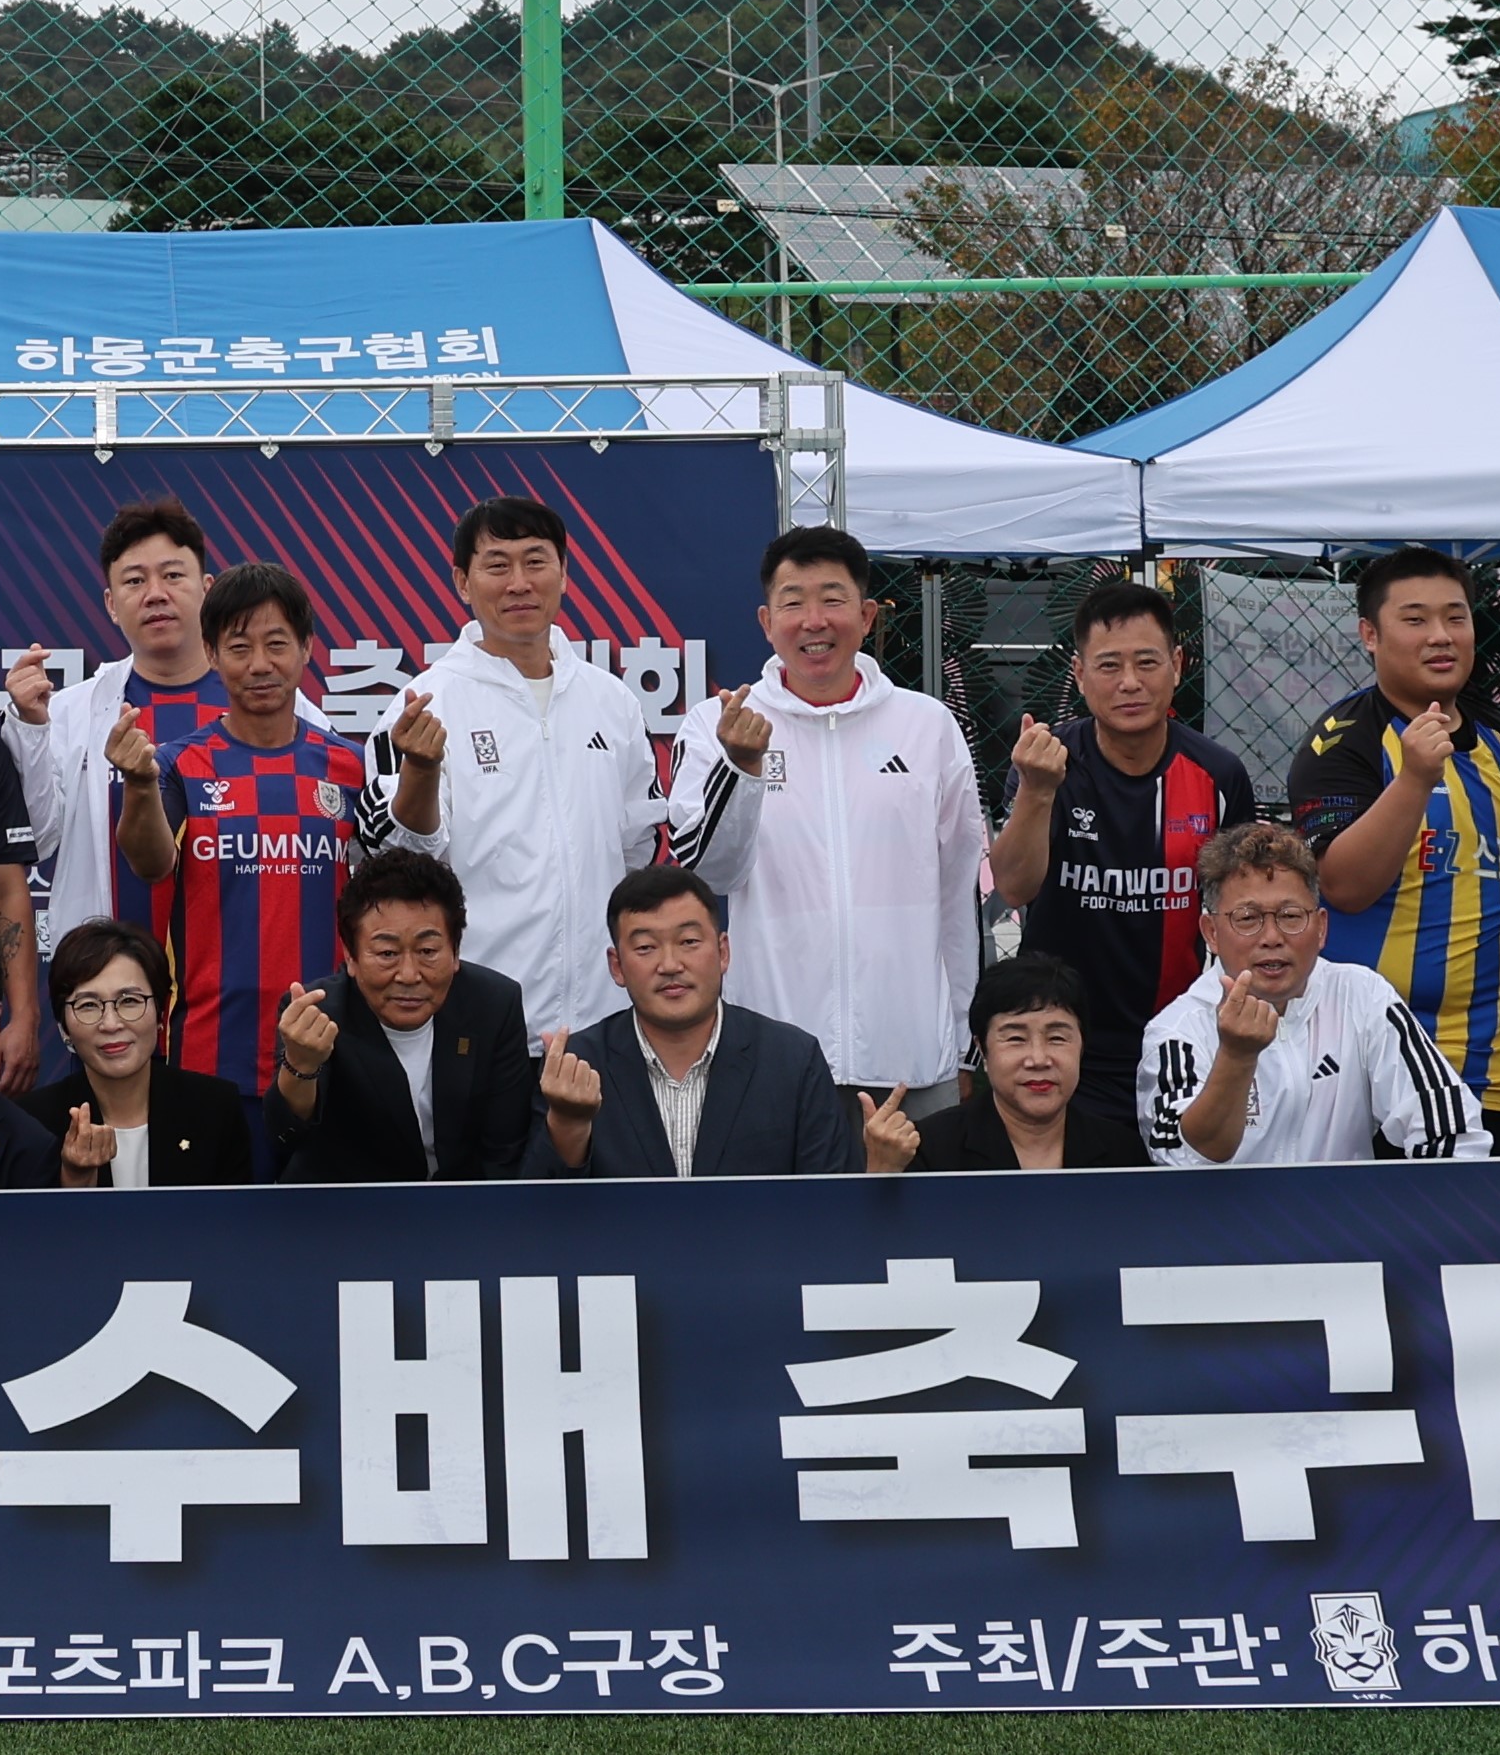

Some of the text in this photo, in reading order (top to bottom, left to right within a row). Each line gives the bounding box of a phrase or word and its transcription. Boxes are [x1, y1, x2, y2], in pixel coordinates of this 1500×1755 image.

[15, 326, 499, 377] 하동군축구협회
[481, 765, 499, 774] HFA
[766, 784, 784, 793] HFA
[200, 800, 235, 812] hummel
[1067, 827, 1099, 842] hummel
[193, 834, 348, 862] GEUMNAM
[235, 864, 323, 876] HAPPY LIFE CITY
[1059, 860, 1198, 897] HANWOO
[1080, 895, 1190, 913] FOOTBALL CLUB
[890, 1614, 1288, 1692] 주최/주관:
